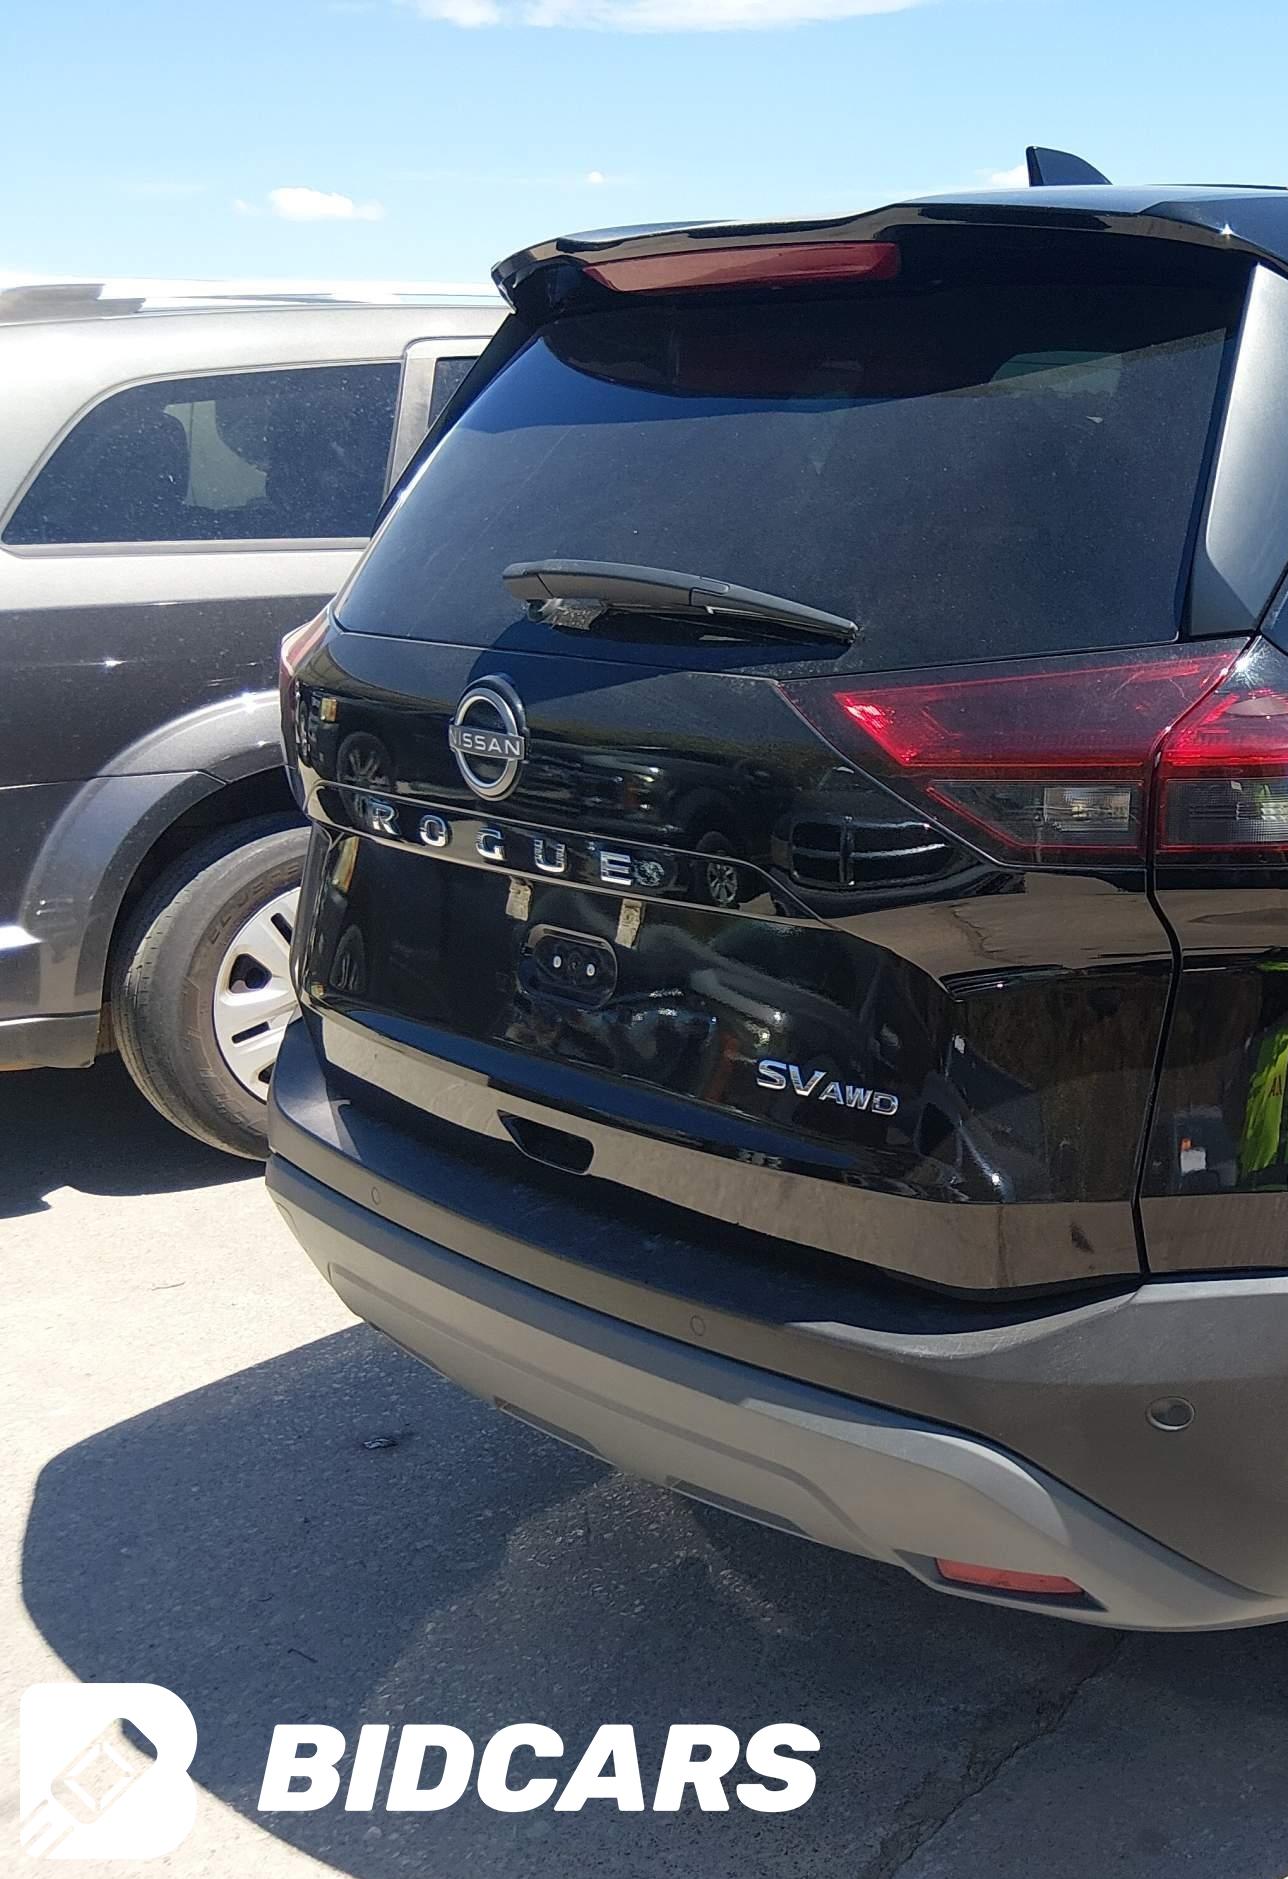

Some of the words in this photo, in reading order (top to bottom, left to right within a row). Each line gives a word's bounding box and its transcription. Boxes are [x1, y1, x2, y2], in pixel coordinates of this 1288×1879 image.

[449, 729, 522, 756] NISSAN
[370, 799, 632, 887] ROGUE
[756, 1059, 827, 1097] SV
[818, 1081, 899, 1116] AWD
